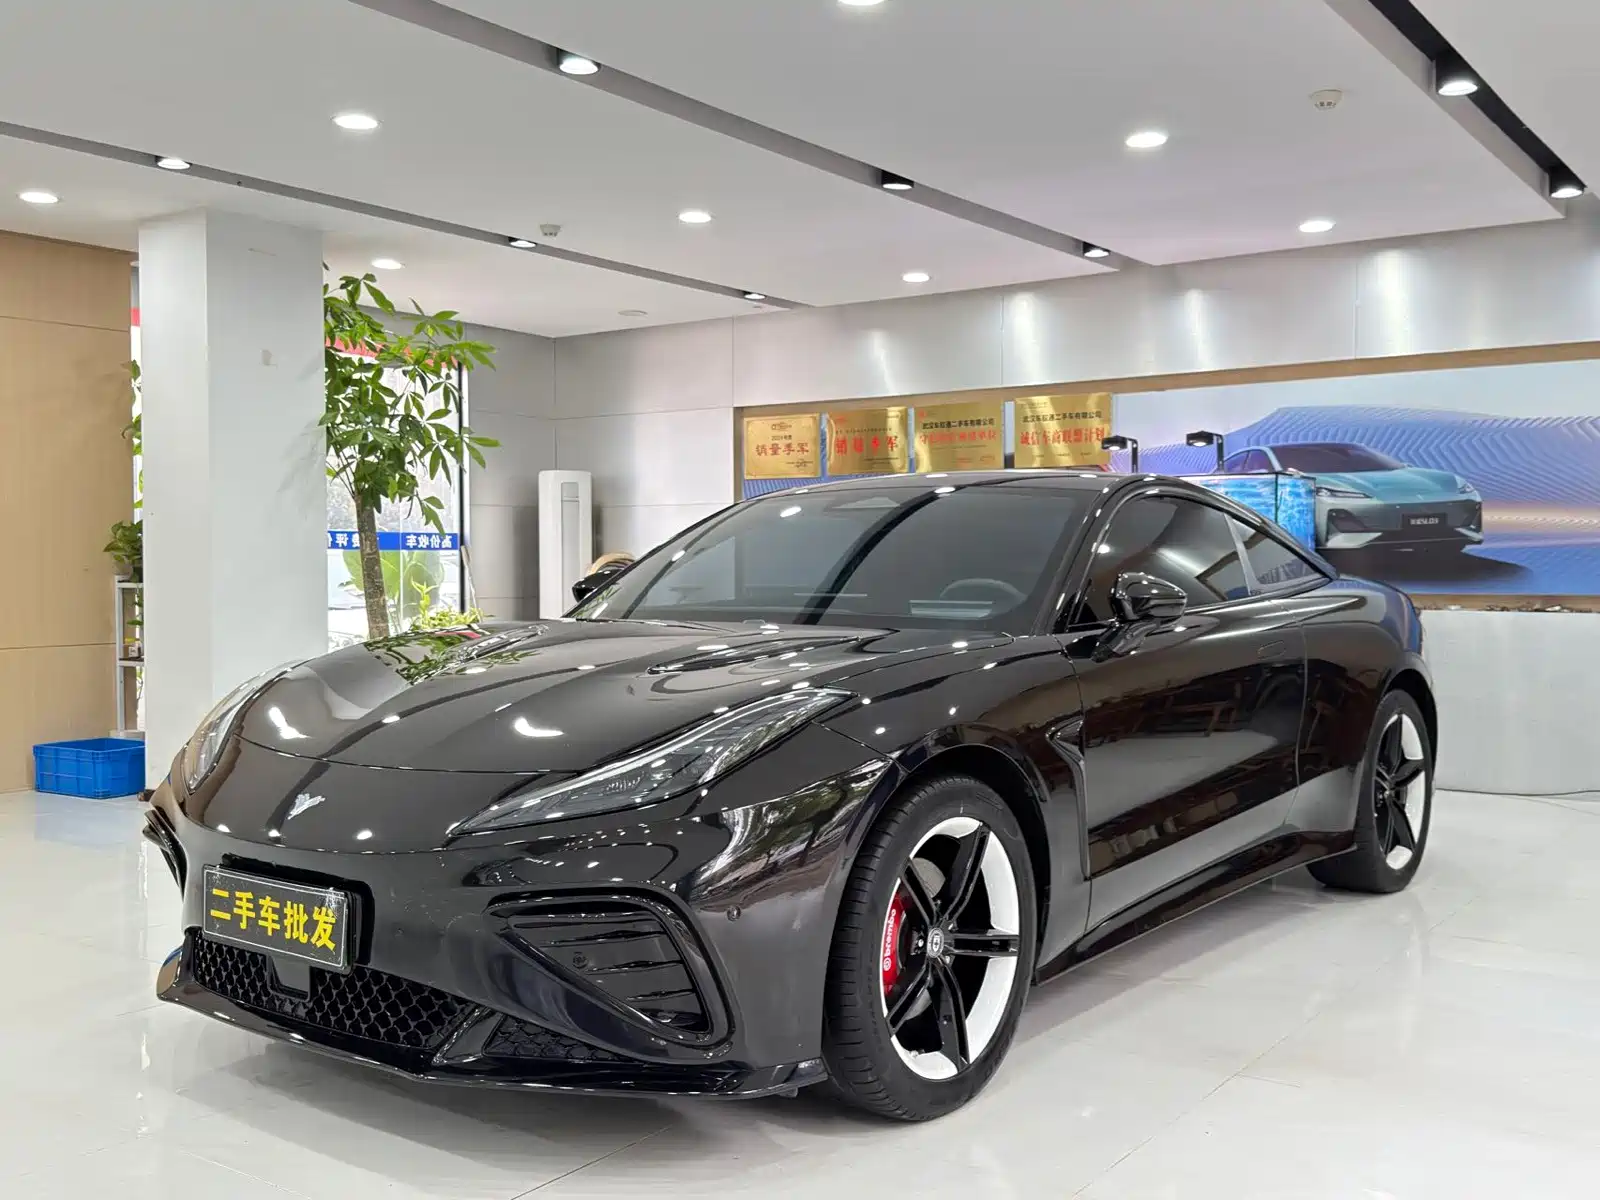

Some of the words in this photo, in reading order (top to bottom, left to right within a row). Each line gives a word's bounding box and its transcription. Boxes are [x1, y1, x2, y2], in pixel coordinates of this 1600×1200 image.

[210, 887, 337, 952] 二手车批发
[883, 908, 897, 957] brembo
